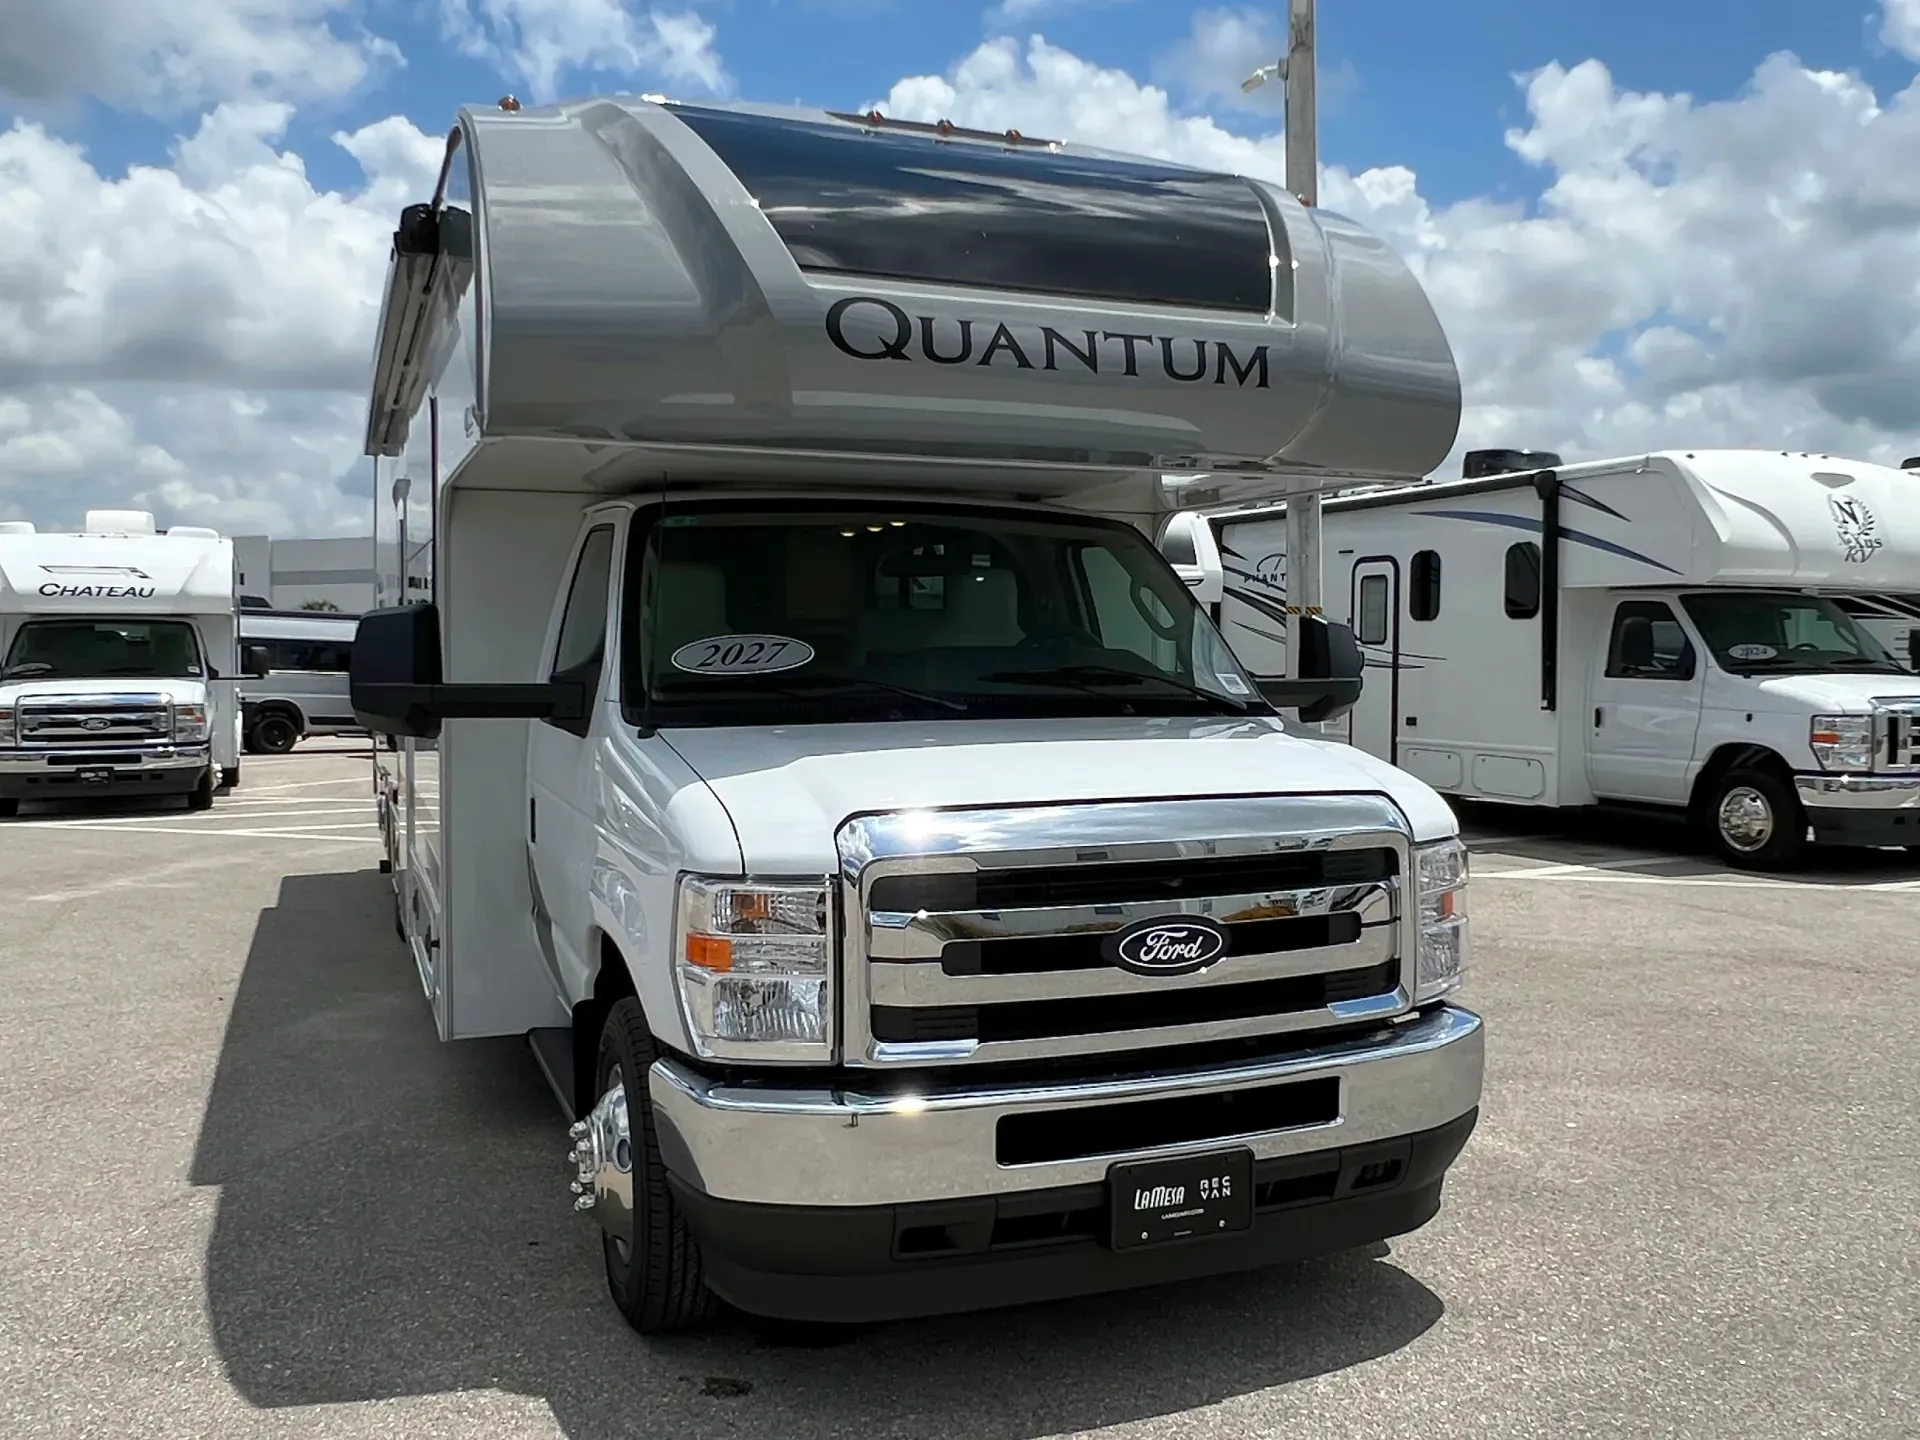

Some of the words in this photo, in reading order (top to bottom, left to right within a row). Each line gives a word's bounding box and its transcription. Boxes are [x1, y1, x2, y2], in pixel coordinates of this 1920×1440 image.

[825, 296, 1270, 389] QUANTUM
[38, 582, 155, 598] CHATEAU
[697, 642, 790, 668] 2027
[1139, 930, 1203, 961] Ford
[1200, 1175, 1231, 1191] REC
[1200, 1187, 1231, 1200] VAN
